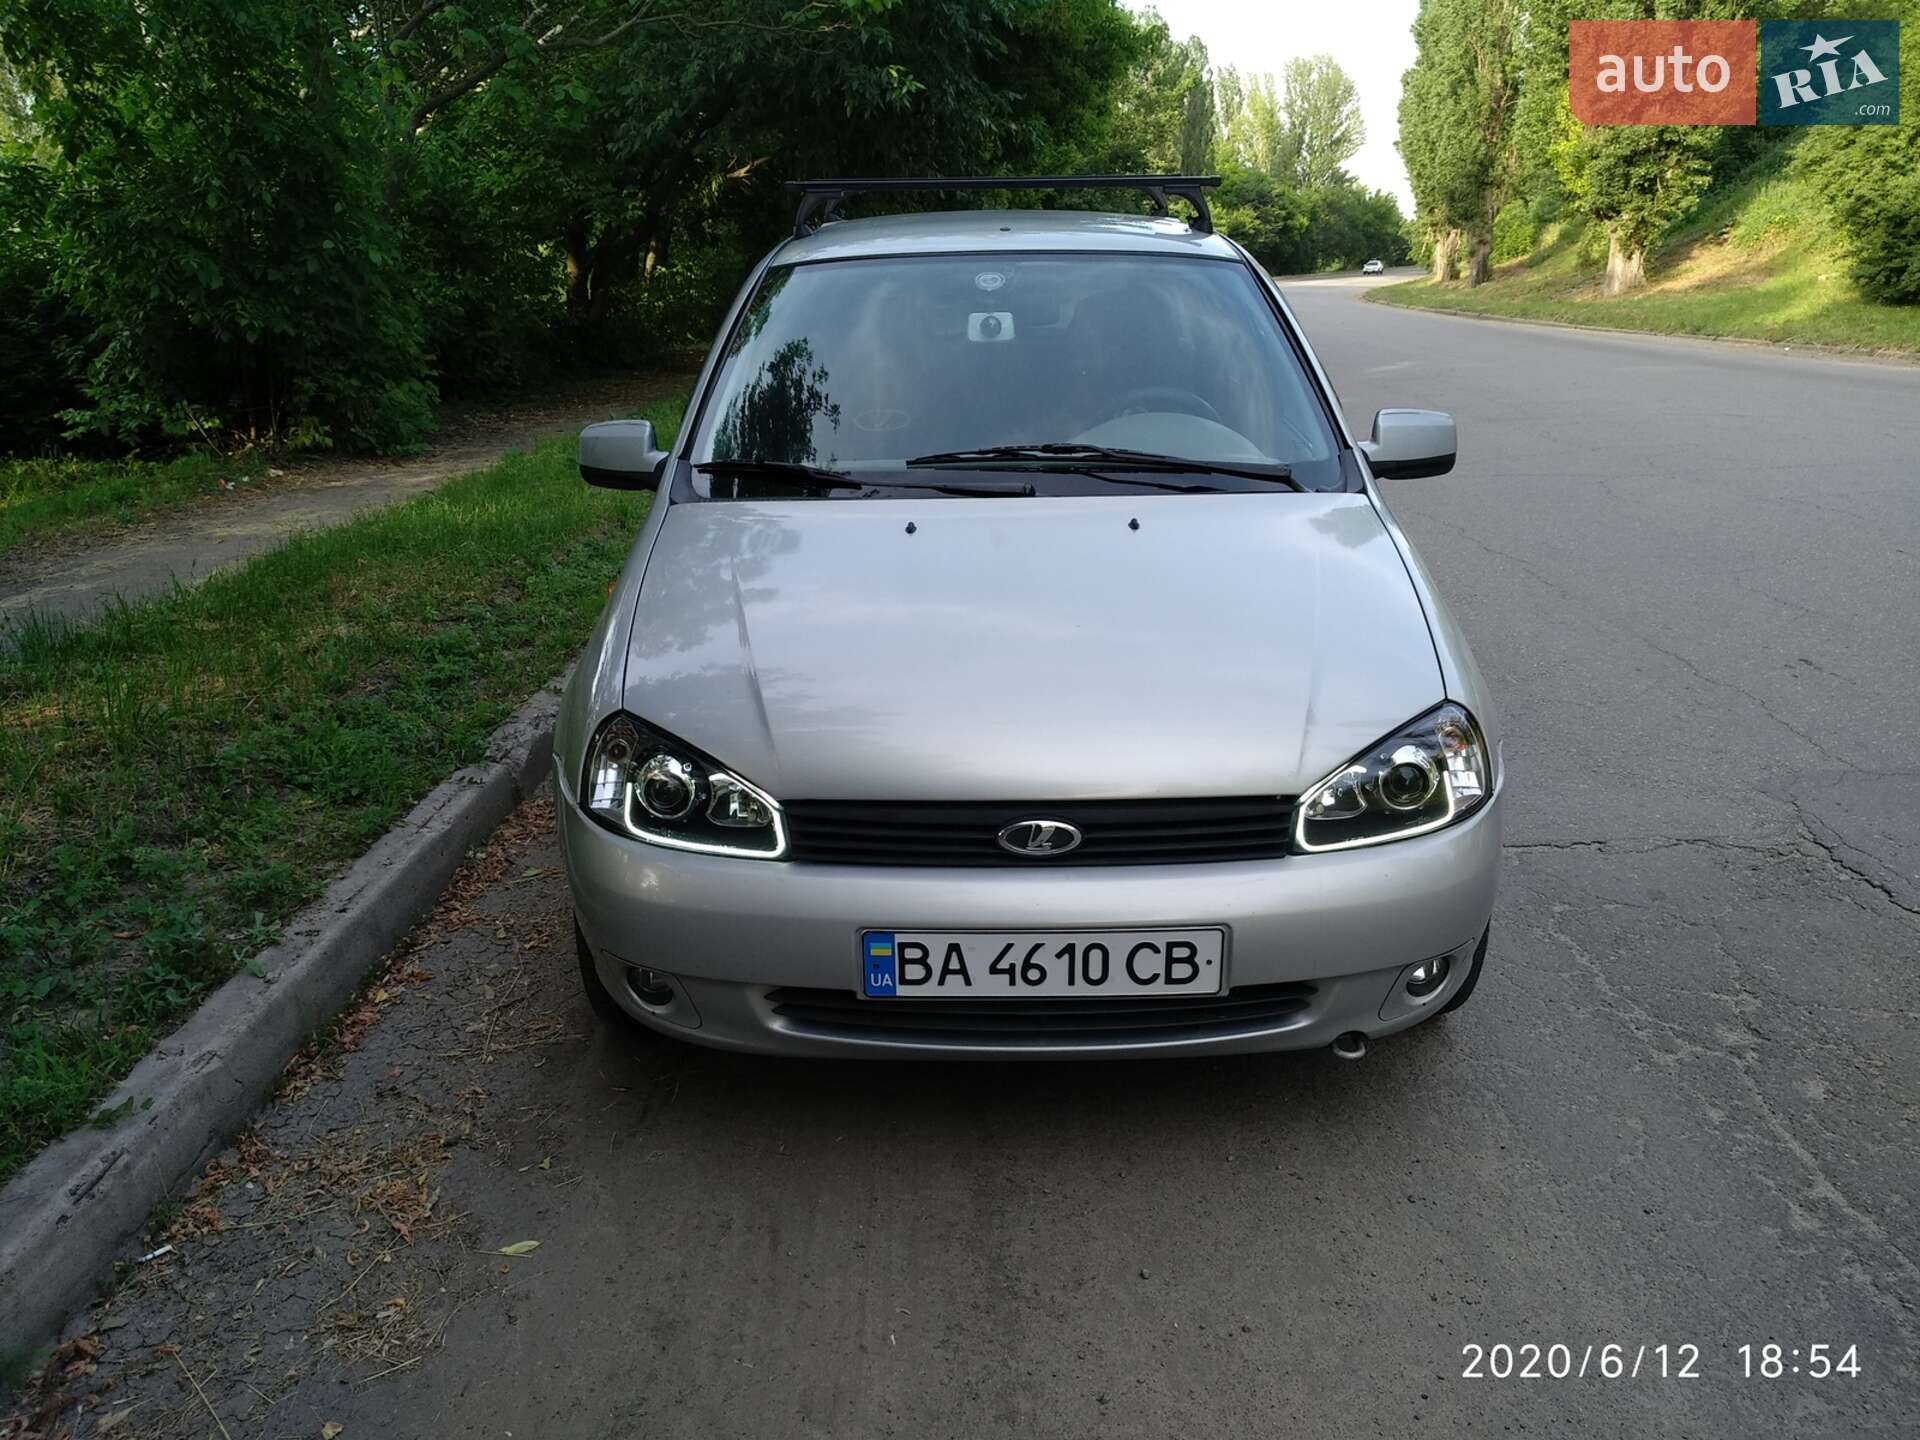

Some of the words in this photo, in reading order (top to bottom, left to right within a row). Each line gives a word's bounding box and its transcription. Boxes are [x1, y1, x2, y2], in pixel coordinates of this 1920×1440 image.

[897, 941, 973, 987] BA
[988, 941, 1110, 987] 4610
[1125, 941, 1200, 986] CB
[870, 973, 893, 987] UA
